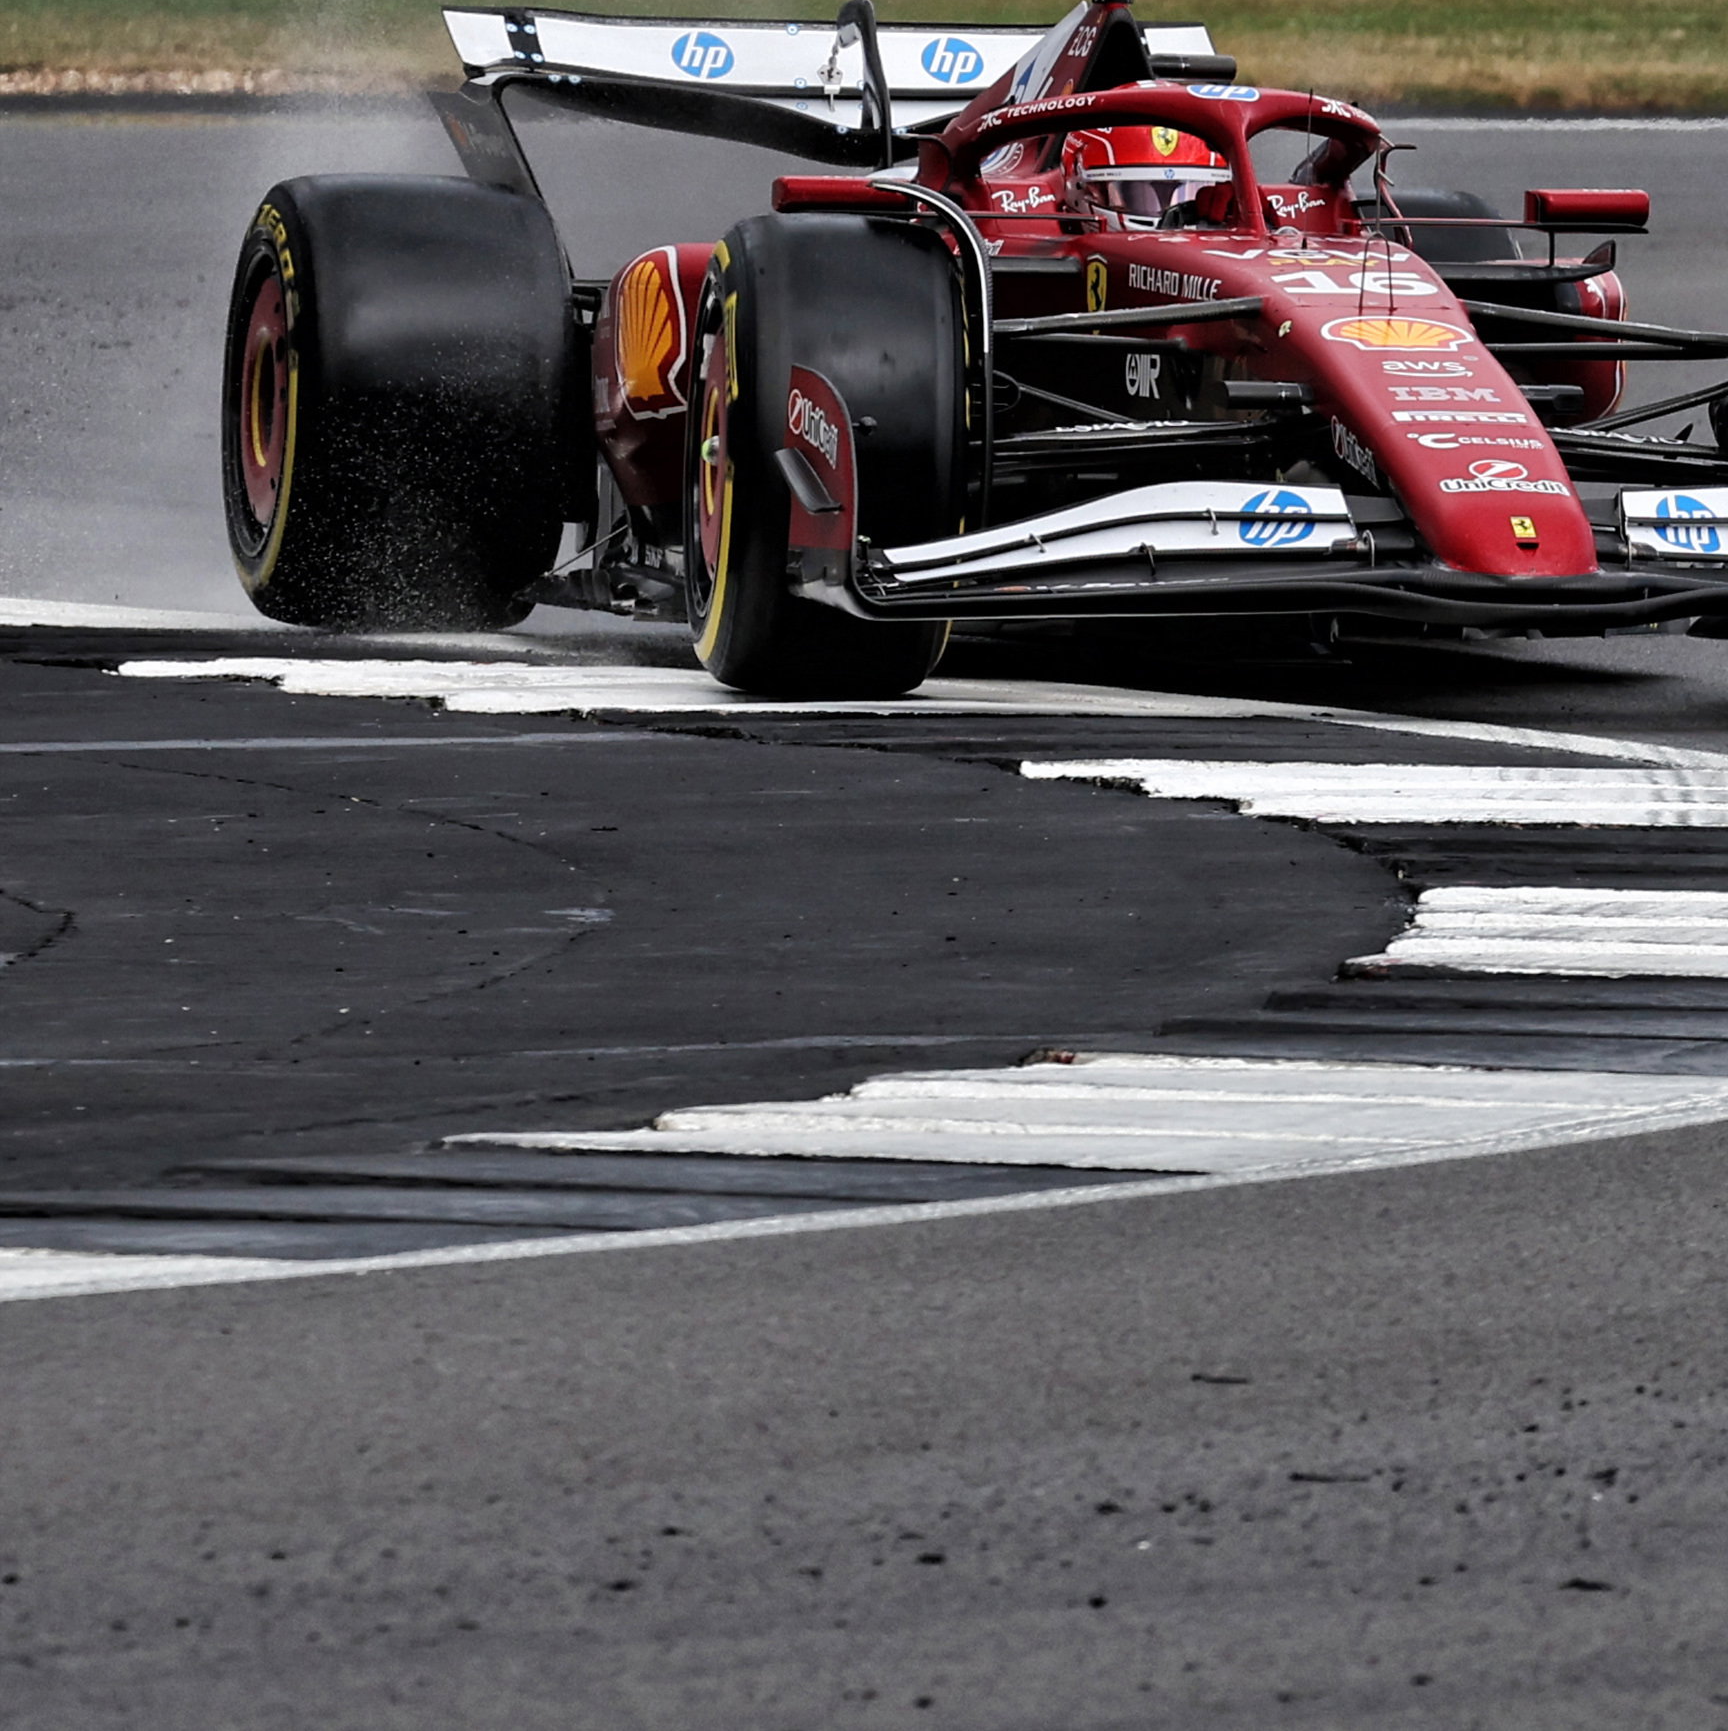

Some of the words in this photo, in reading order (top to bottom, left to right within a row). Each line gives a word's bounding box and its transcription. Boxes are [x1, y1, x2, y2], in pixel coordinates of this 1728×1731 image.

[678, 31, 730, 79] hp
[927, 37, 979, 85] hp
[1007, 96, 1096, 119] TECHNOLOGY
[1128, 263, 1179, 297] RICHARD
[1181, 273, 1222, 302] MILLE
[1270, 270, 1439, 296] 16
[1381, 360, 1468, 373] aws
[1387, 386, 1502, 402] IBM
[1391, 410, 1528, 423] PIRELLI
[1457, 436, 1545, 448] CELSIUS
[1440, 477, 1571, 497] UniCredit
